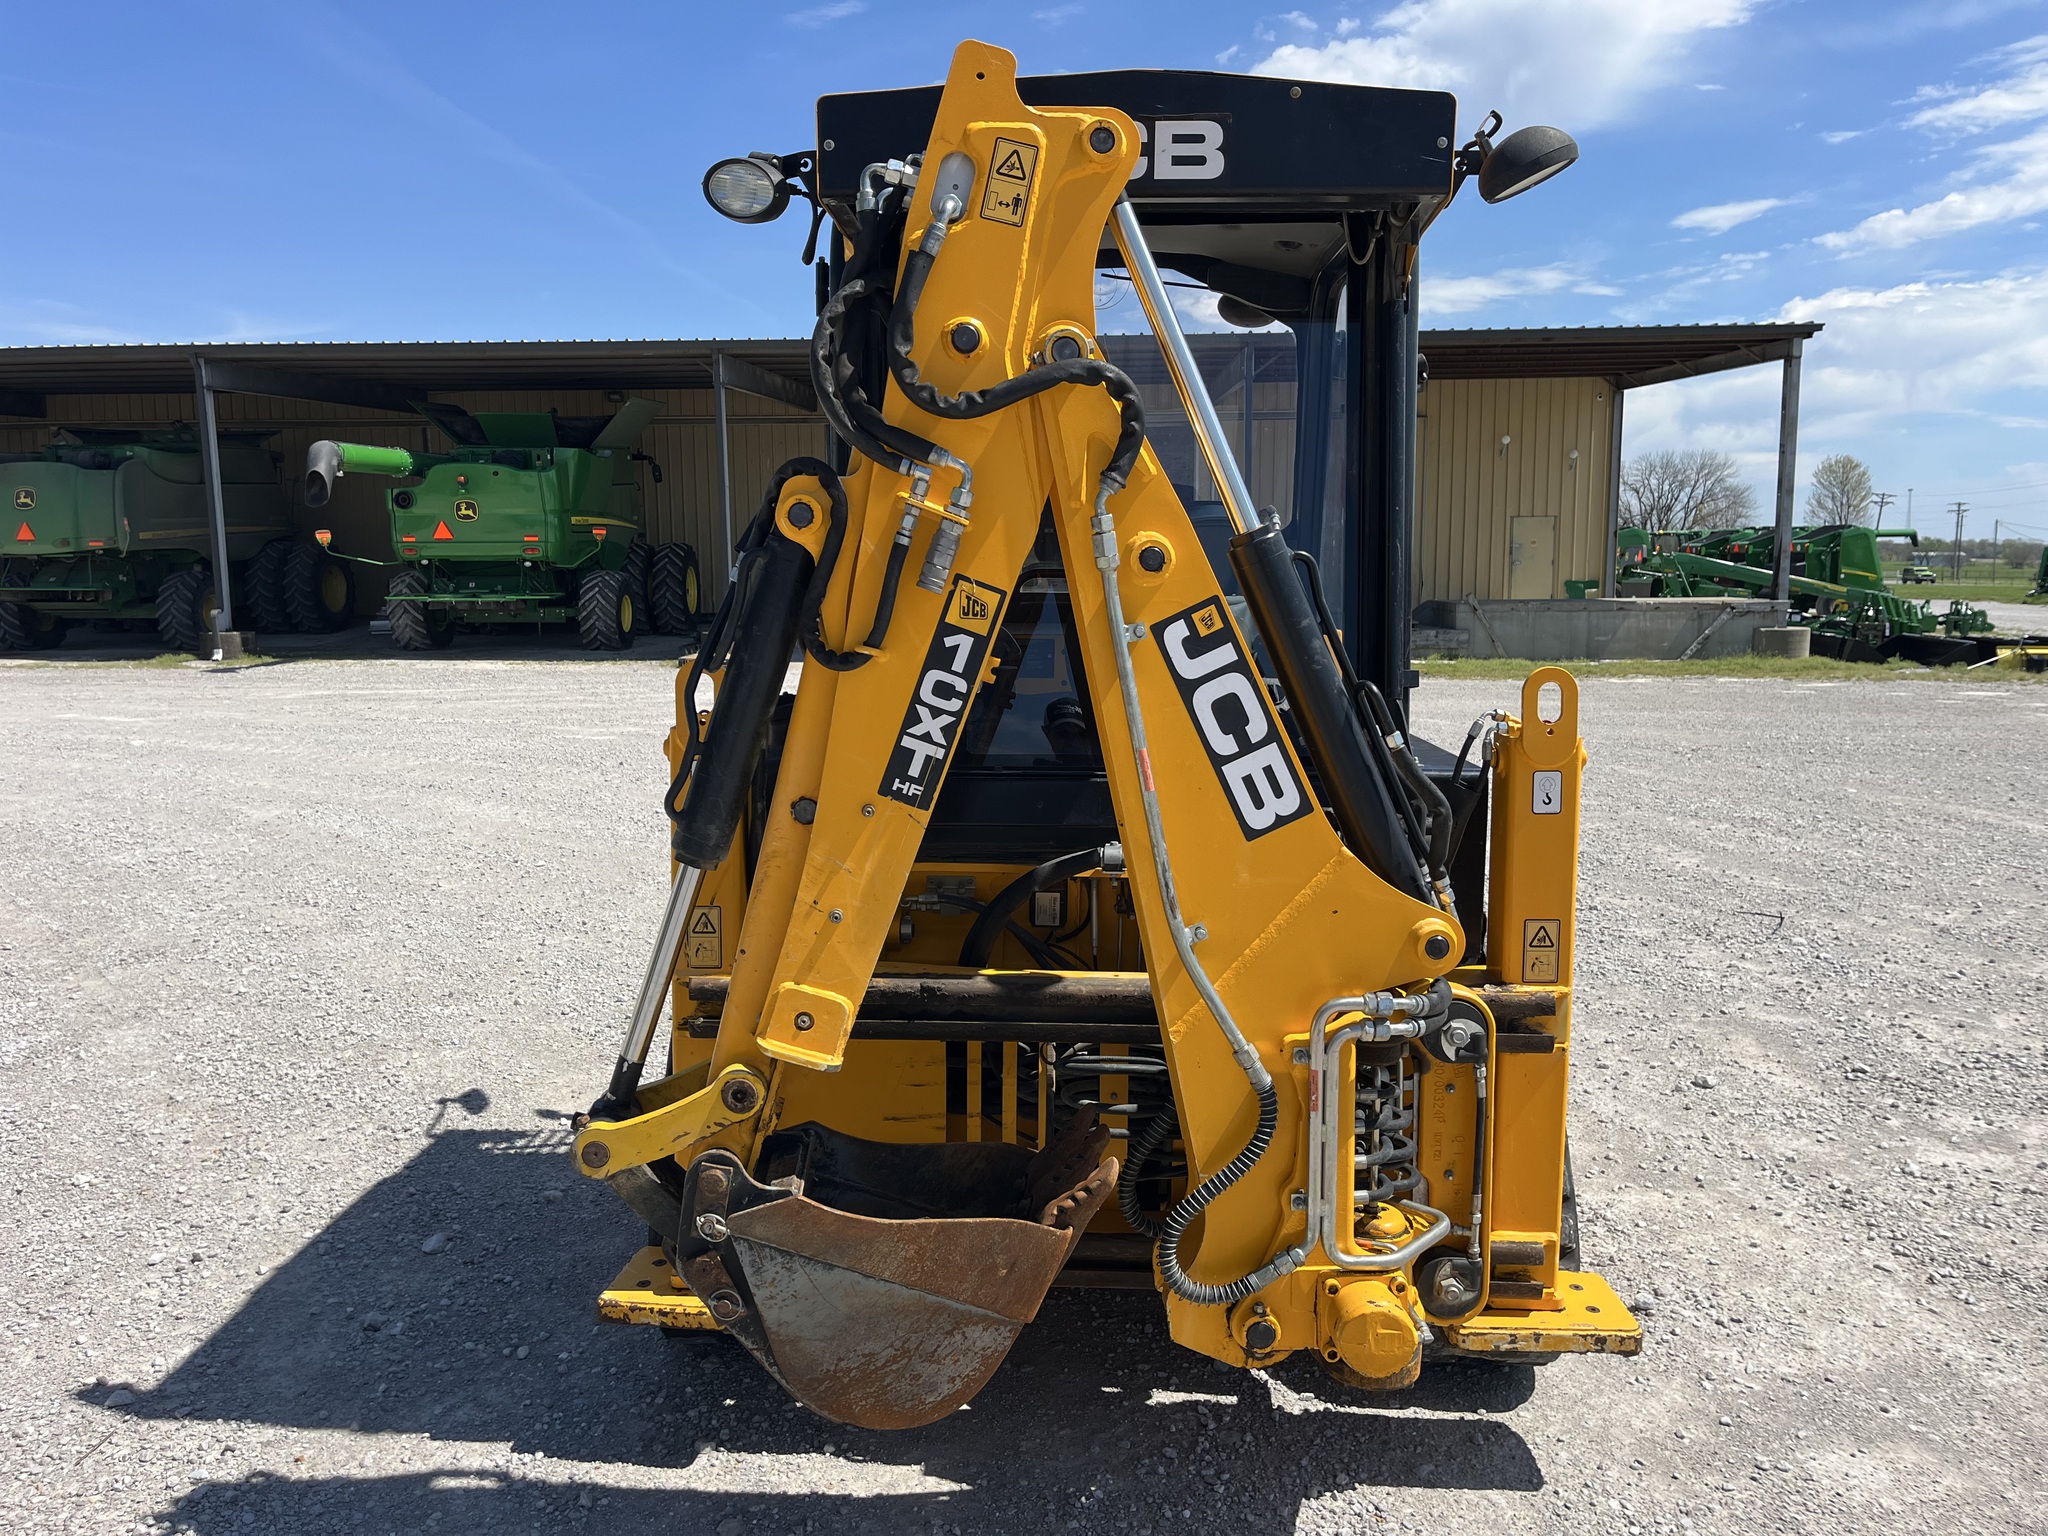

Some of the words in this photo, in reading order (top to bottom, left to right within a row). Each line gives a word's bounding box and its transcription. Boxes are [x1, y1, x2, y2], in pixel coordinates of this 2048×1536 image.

[962, 592, 987, 618] JCB
[1200, 611, 1215, 630] JCB
[900, 633, 975, 778] 1CXT
[1163, 618, 1301, 830] JCB
[891, 778, 925, 797] HF
